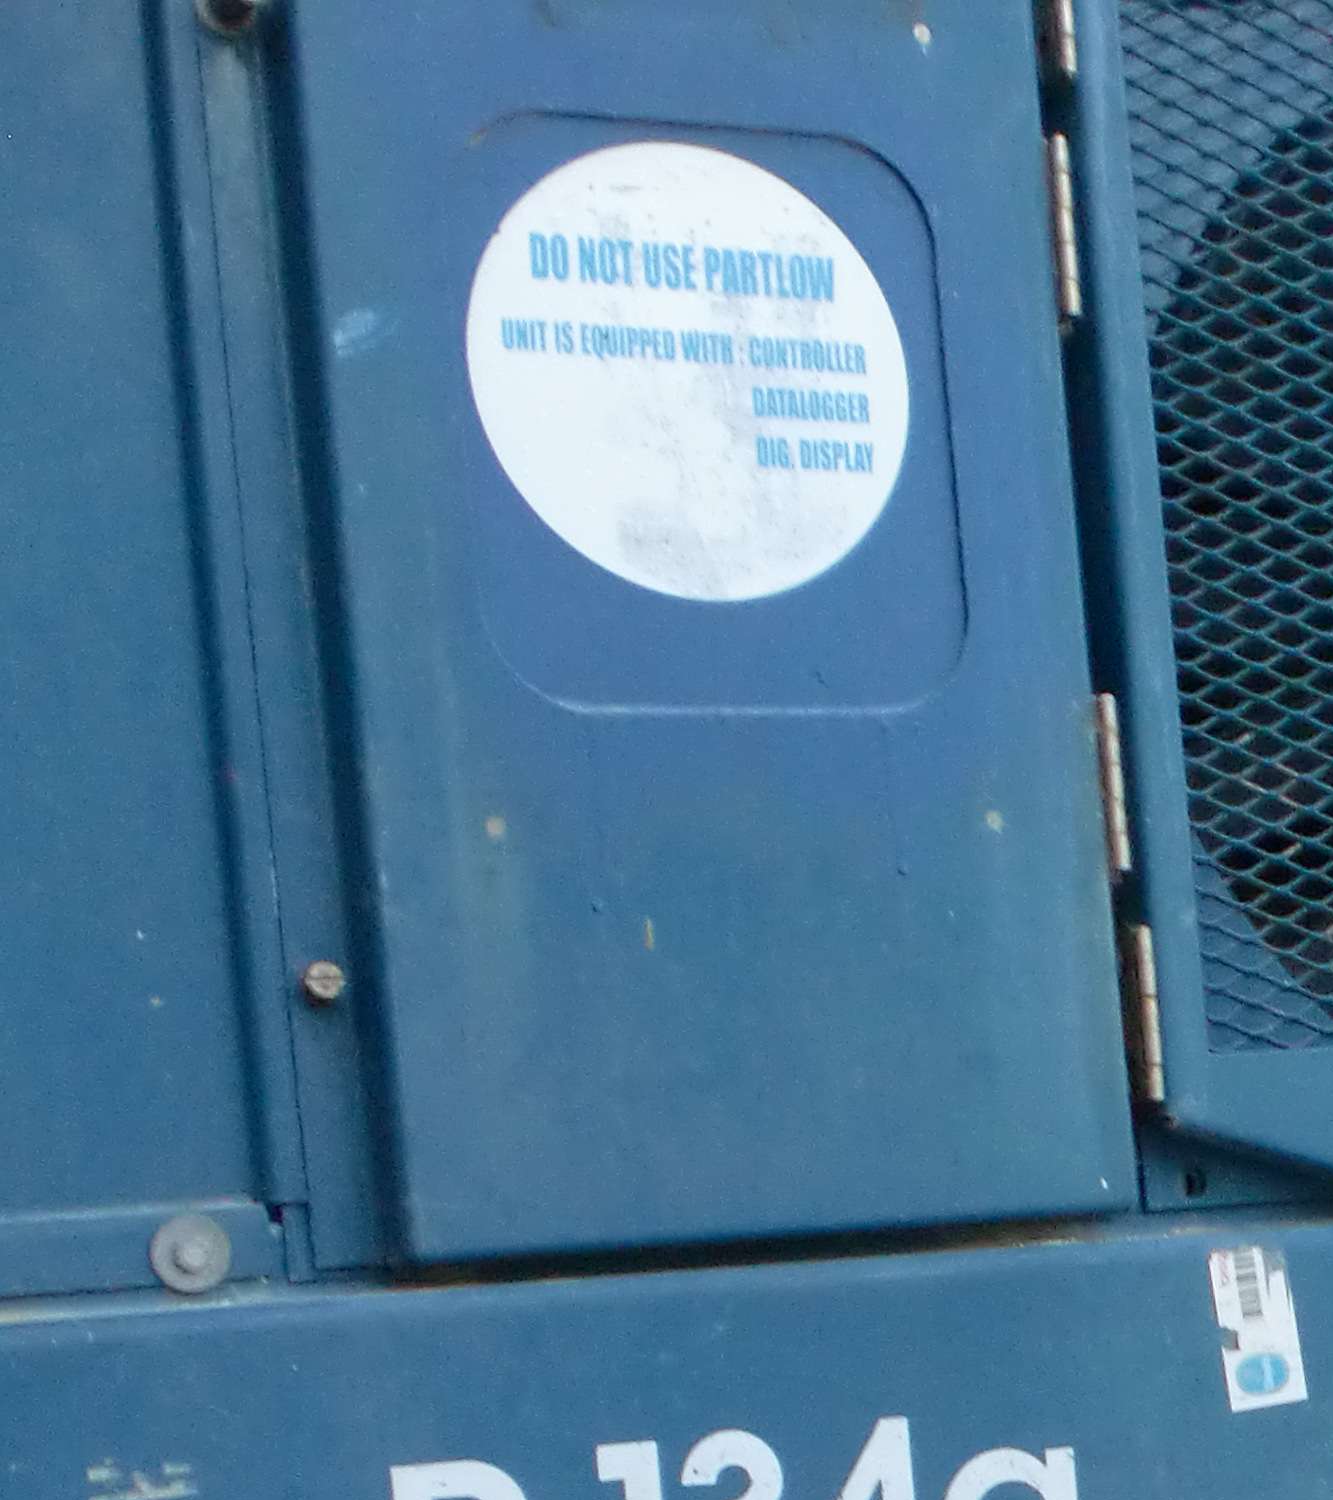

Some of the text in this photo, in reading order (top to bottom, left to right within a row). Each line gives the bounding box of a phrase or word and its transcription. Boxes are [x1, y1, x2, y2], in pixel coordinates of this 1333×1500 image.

[529, 231, 836, 303] DO NOT USE PARTLOW
[500, 317, 547, 352] UNIT
[554, 319, 575, 355] IS
[580, 321, 677, 363] EQUIPPED
[680, 328, 734, 365] WITH
[748, 335, 867, 375] CONTROLLER
[752, 386, 871, 424] DATALOGGER
[755, 436, 874, 474] DIG. DISPLAY
